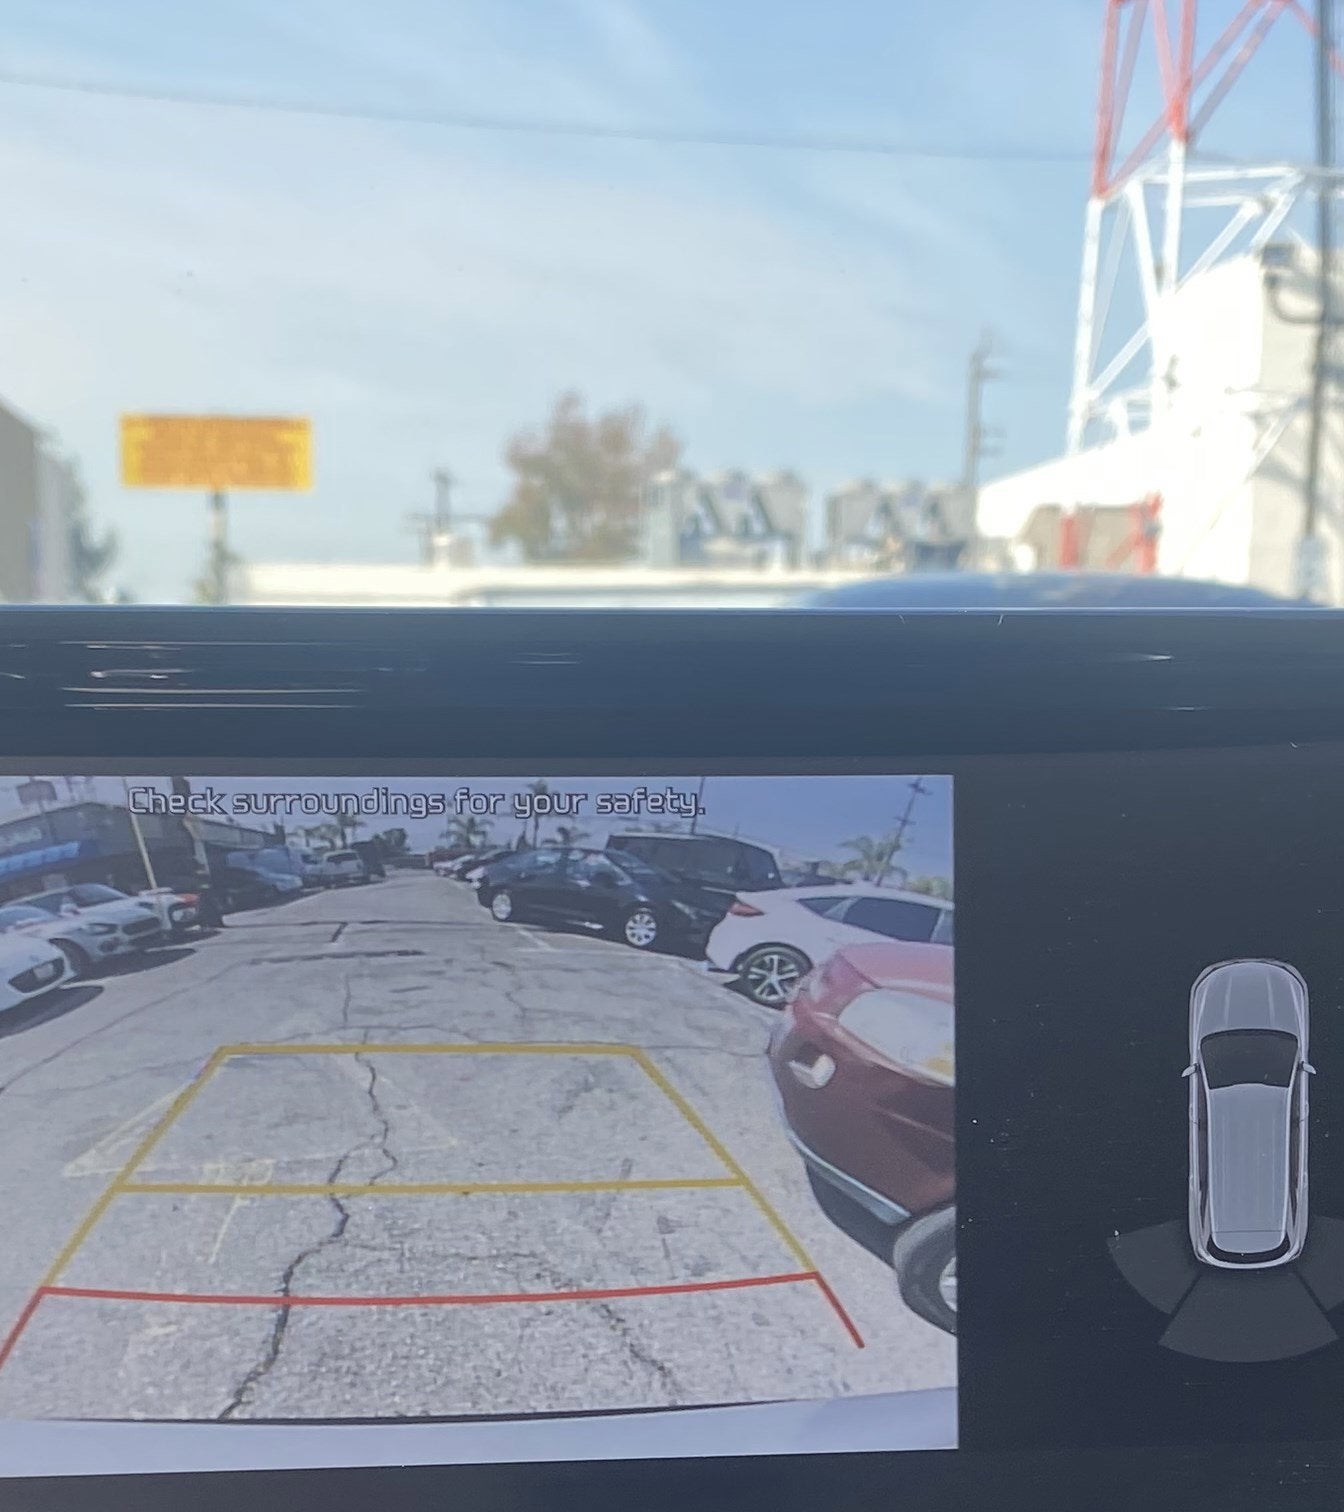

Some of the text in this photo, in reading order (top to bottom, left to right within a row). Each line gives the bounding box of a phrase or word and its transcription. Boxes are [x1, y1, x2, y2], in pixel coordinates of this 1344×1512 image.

[125, 784, 706, 821] Check surroundings for your safety.
